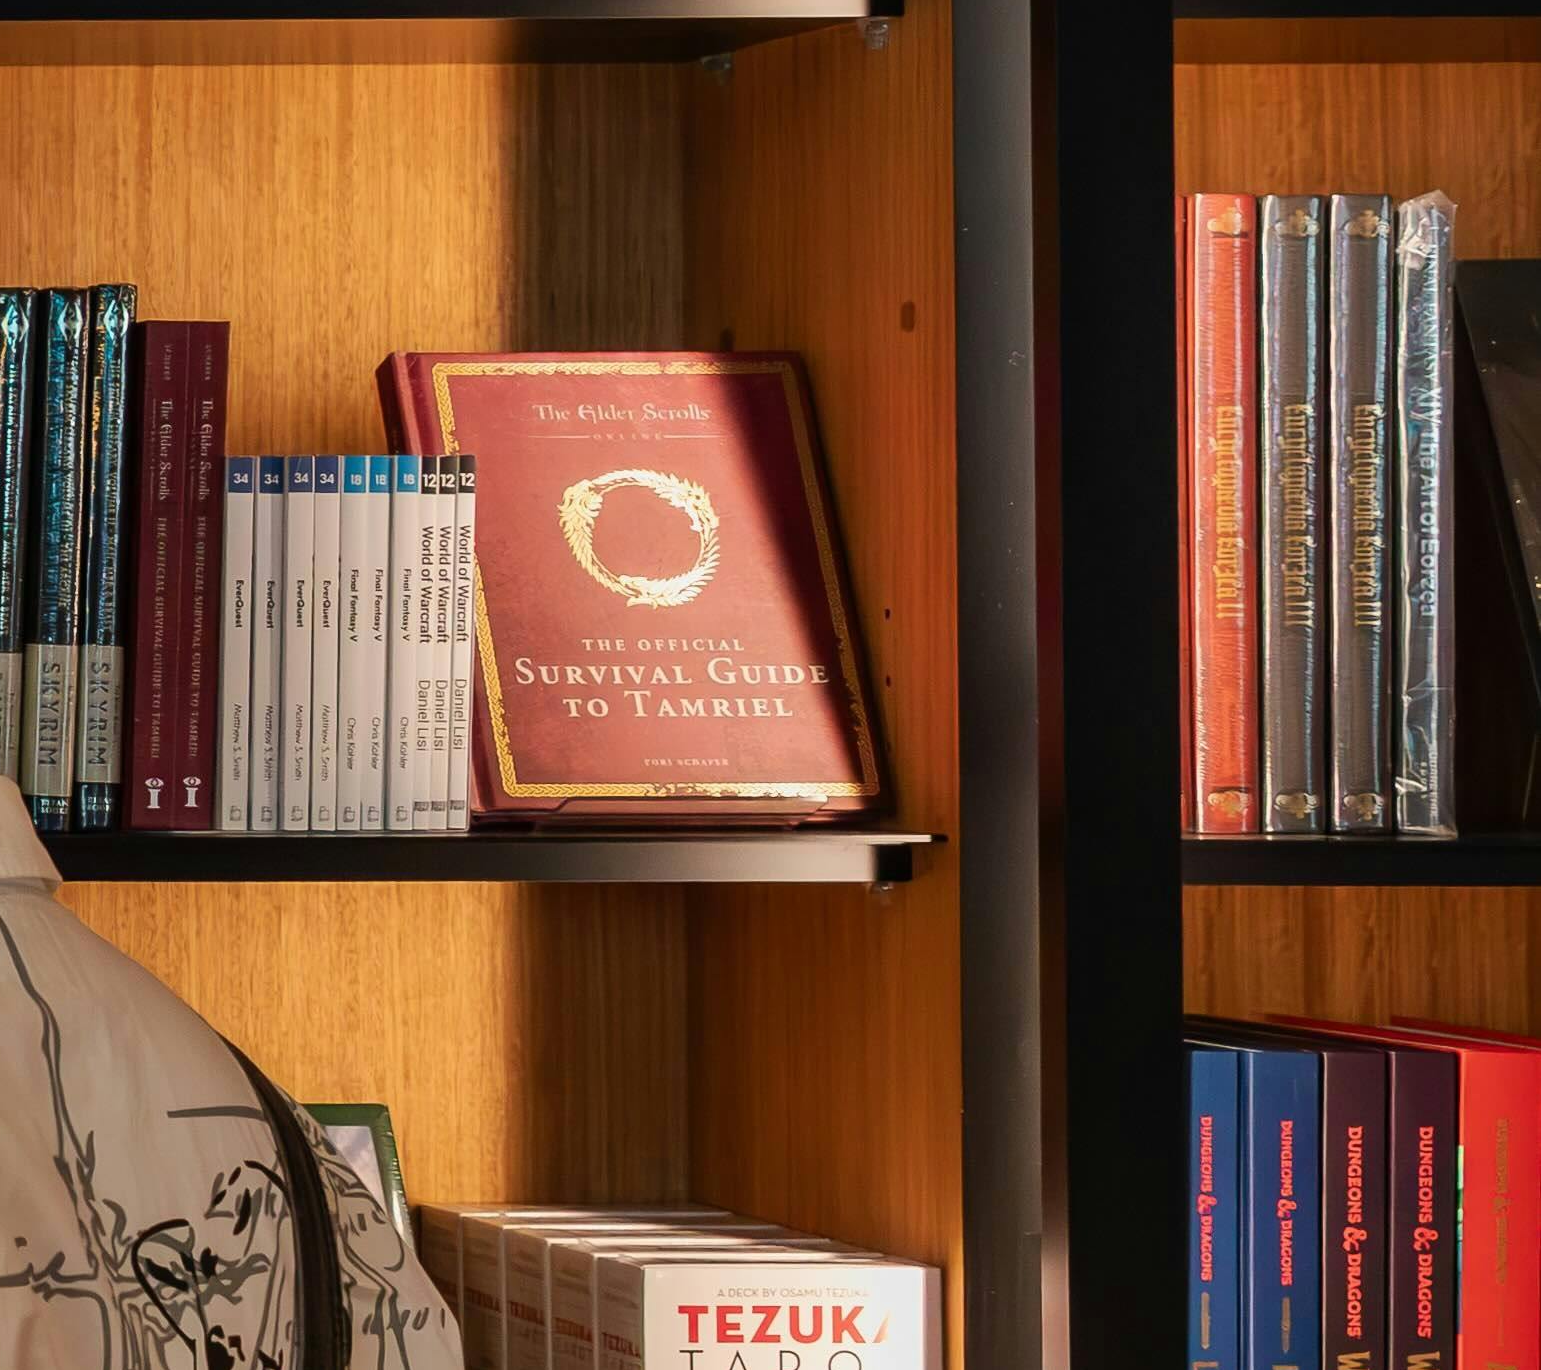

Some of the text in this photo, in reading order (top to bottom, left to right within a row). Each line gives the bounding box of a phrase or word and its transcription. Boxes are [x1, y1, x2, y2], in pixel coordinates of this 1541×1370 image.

[460, 473, 475, 487] 12
[456, 525, 472, 642] World of Warcraft
[582, 637, 744, 652] THE OFFICIAL
[515, 658, 829, 685] SURVIVAL GUIDE
[453, 679, 467, 750] Daniel Lisi
[564, 690, 793, 717] TO TAMRIEL
[1342, 1127, 1367, 1339] DUNGEONS & DRAGONS
